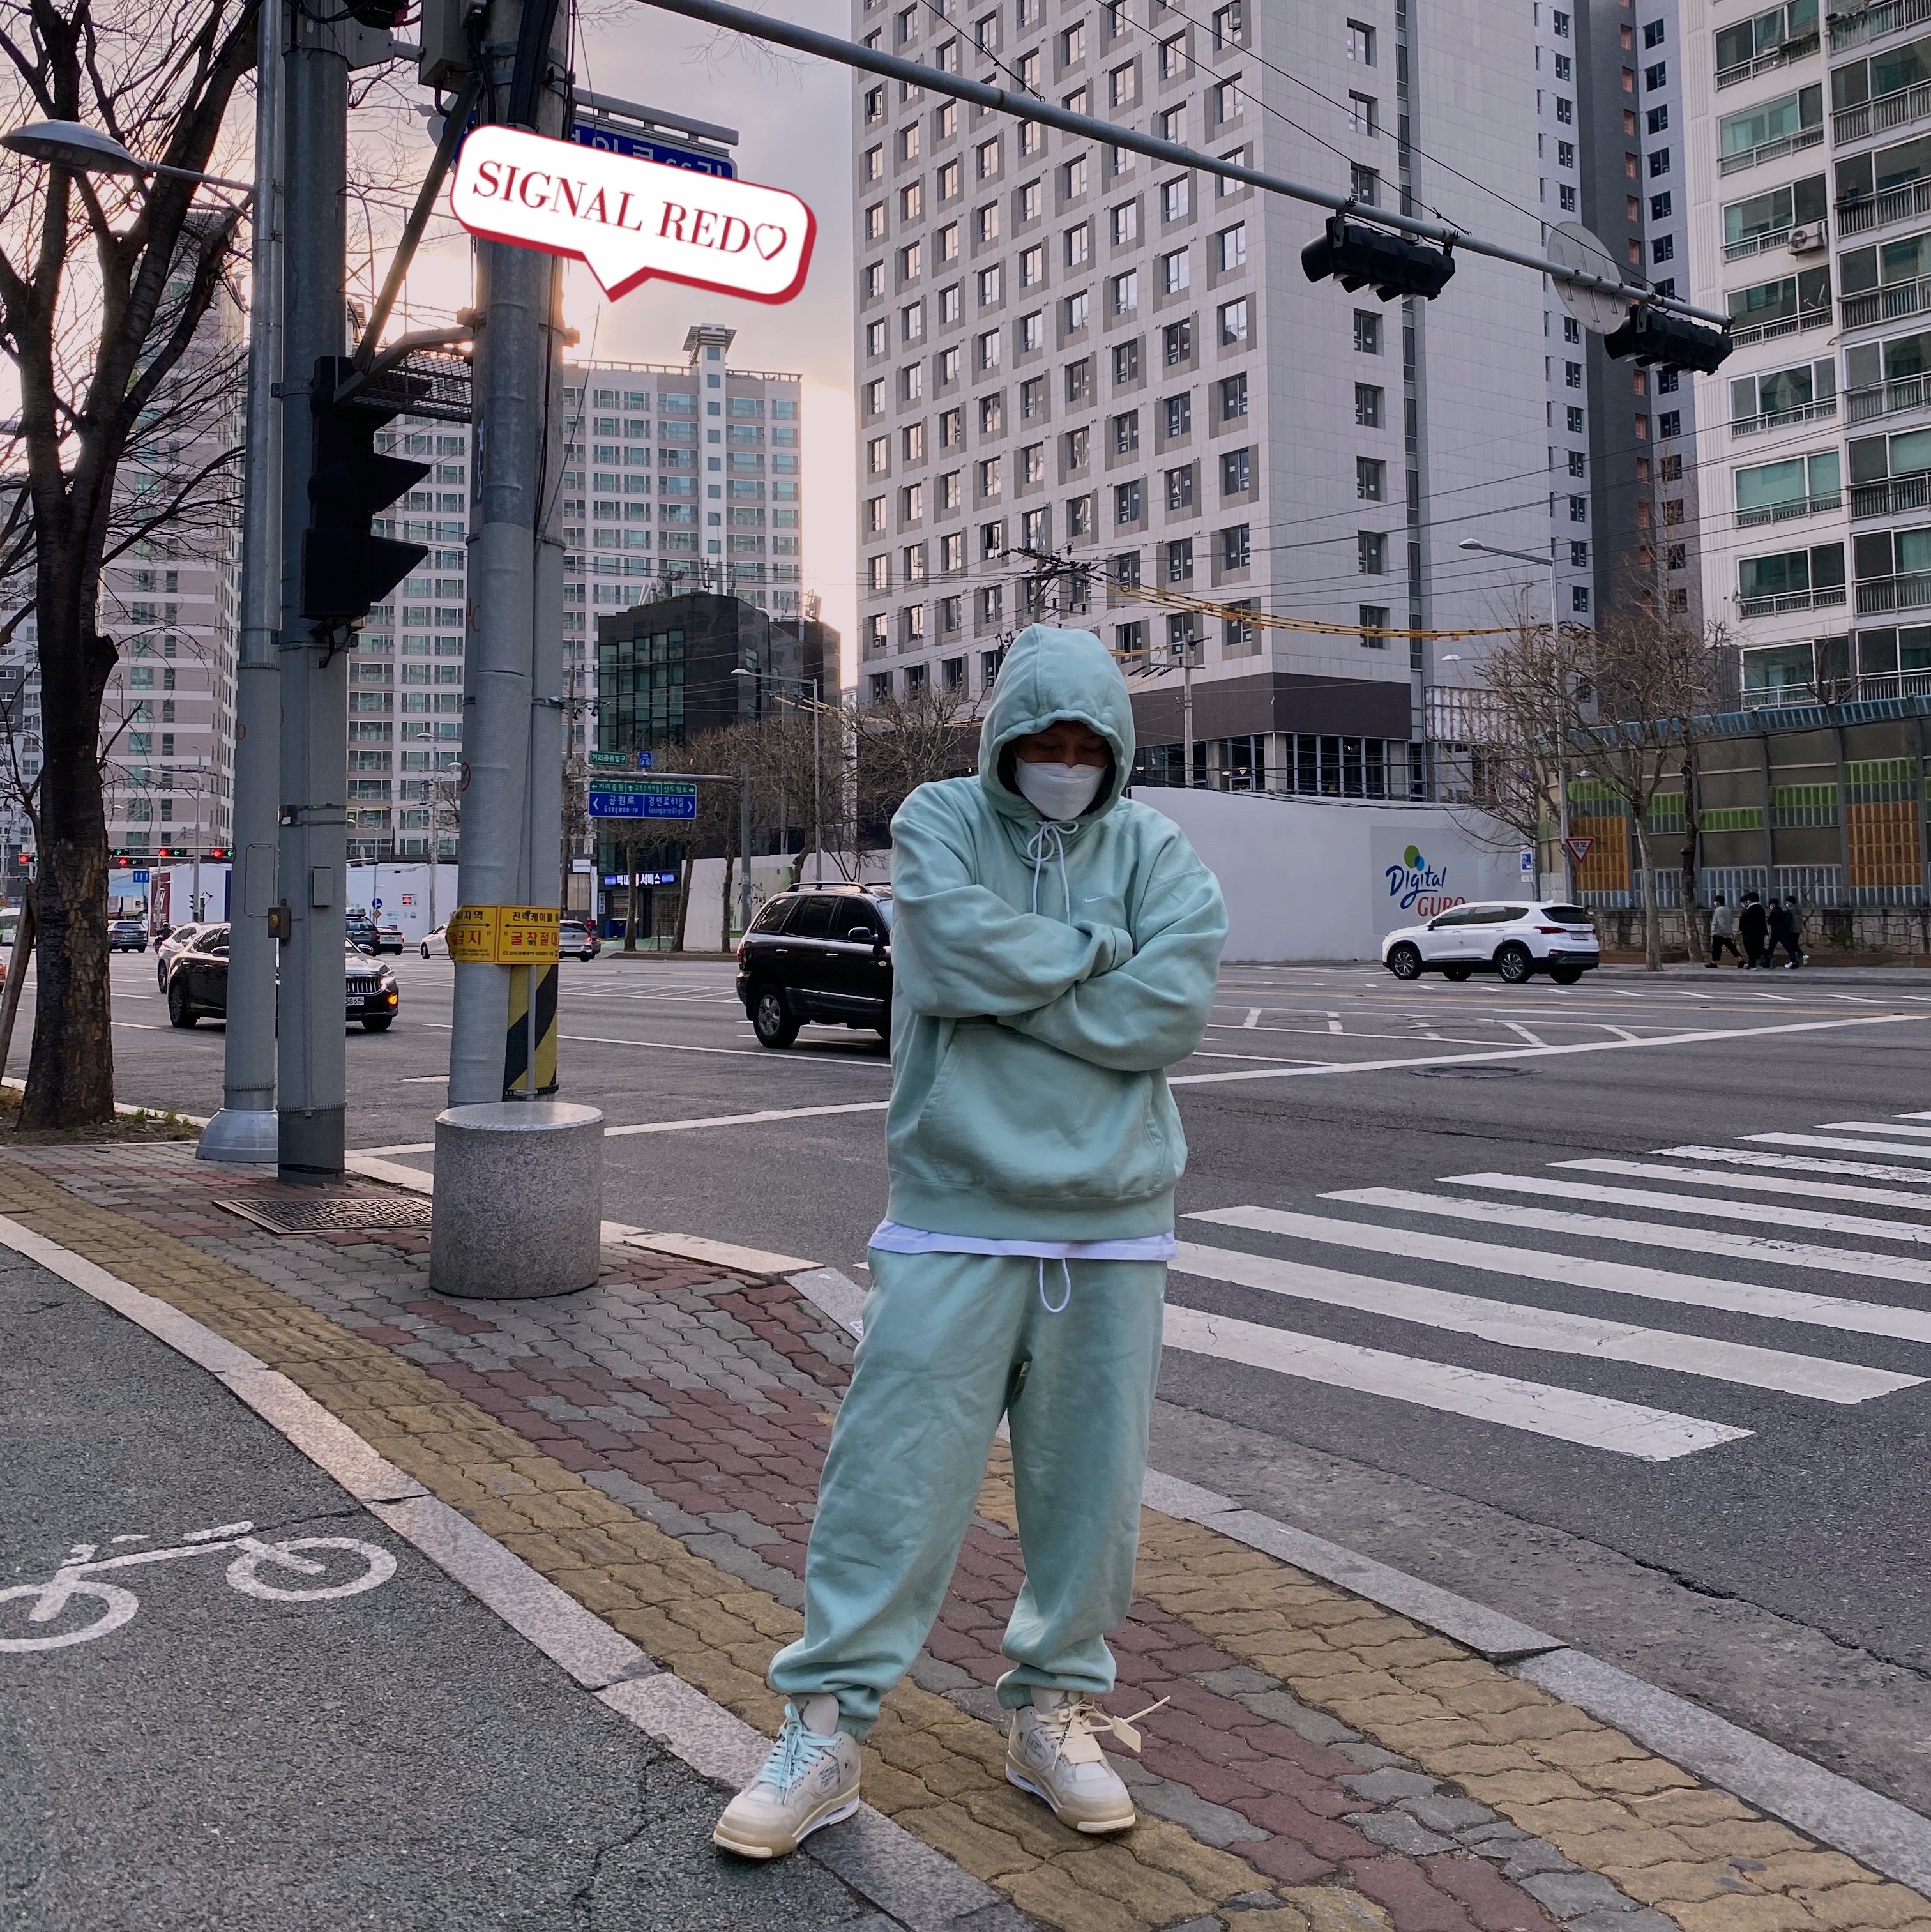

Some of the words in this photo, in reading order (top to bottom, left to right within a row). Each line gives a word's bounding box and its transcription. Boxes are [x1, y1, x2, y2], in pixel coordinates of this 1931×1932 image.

[598, 783, 624, 792] 거리공원
[608, 795, 635, 806] 공원로
[604, 805, 639, 814] Gongwon-ro
[1385, 864, 1447, 909] Digital
